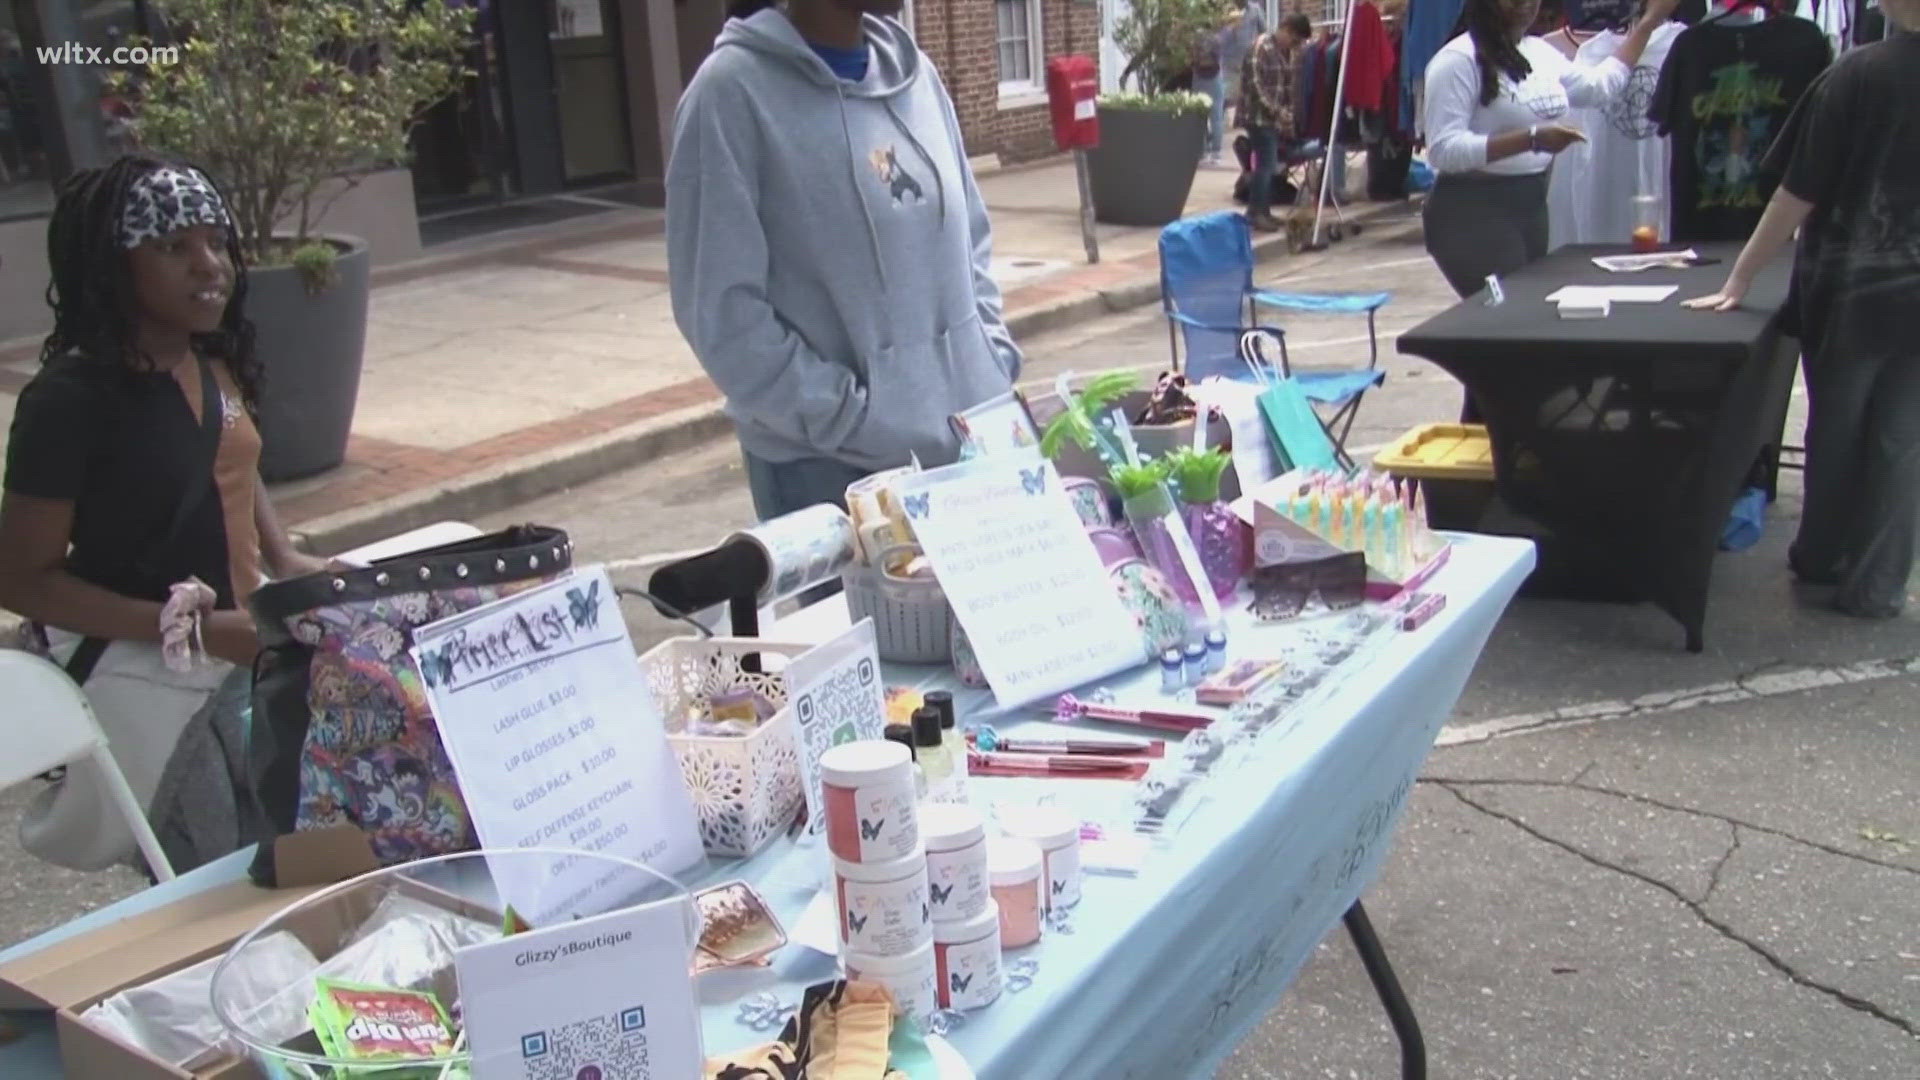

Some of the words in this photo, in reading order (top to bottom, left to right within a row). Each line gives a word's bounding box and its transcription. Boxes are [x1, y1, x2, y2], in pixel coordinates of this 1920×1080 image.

[490, 668, 524, 693] Lashes
[493, 711, 520, 735] LASH
[520, 698, 548, 721] GLUE
[505, 754, 520, 772] LIP
[522, 732, 566, 764] GLOSSES
[512, 783, 548, 812] GLOSS
[546, 772, 572, 793] PACK
[518, 828, 542, 849] SELF
[544, 804, 588, 839] DEFENSE
[587, 778, 633, 812] KEYCHAIN
[514, 930, 633, 968] Glizzy'sBoutique
